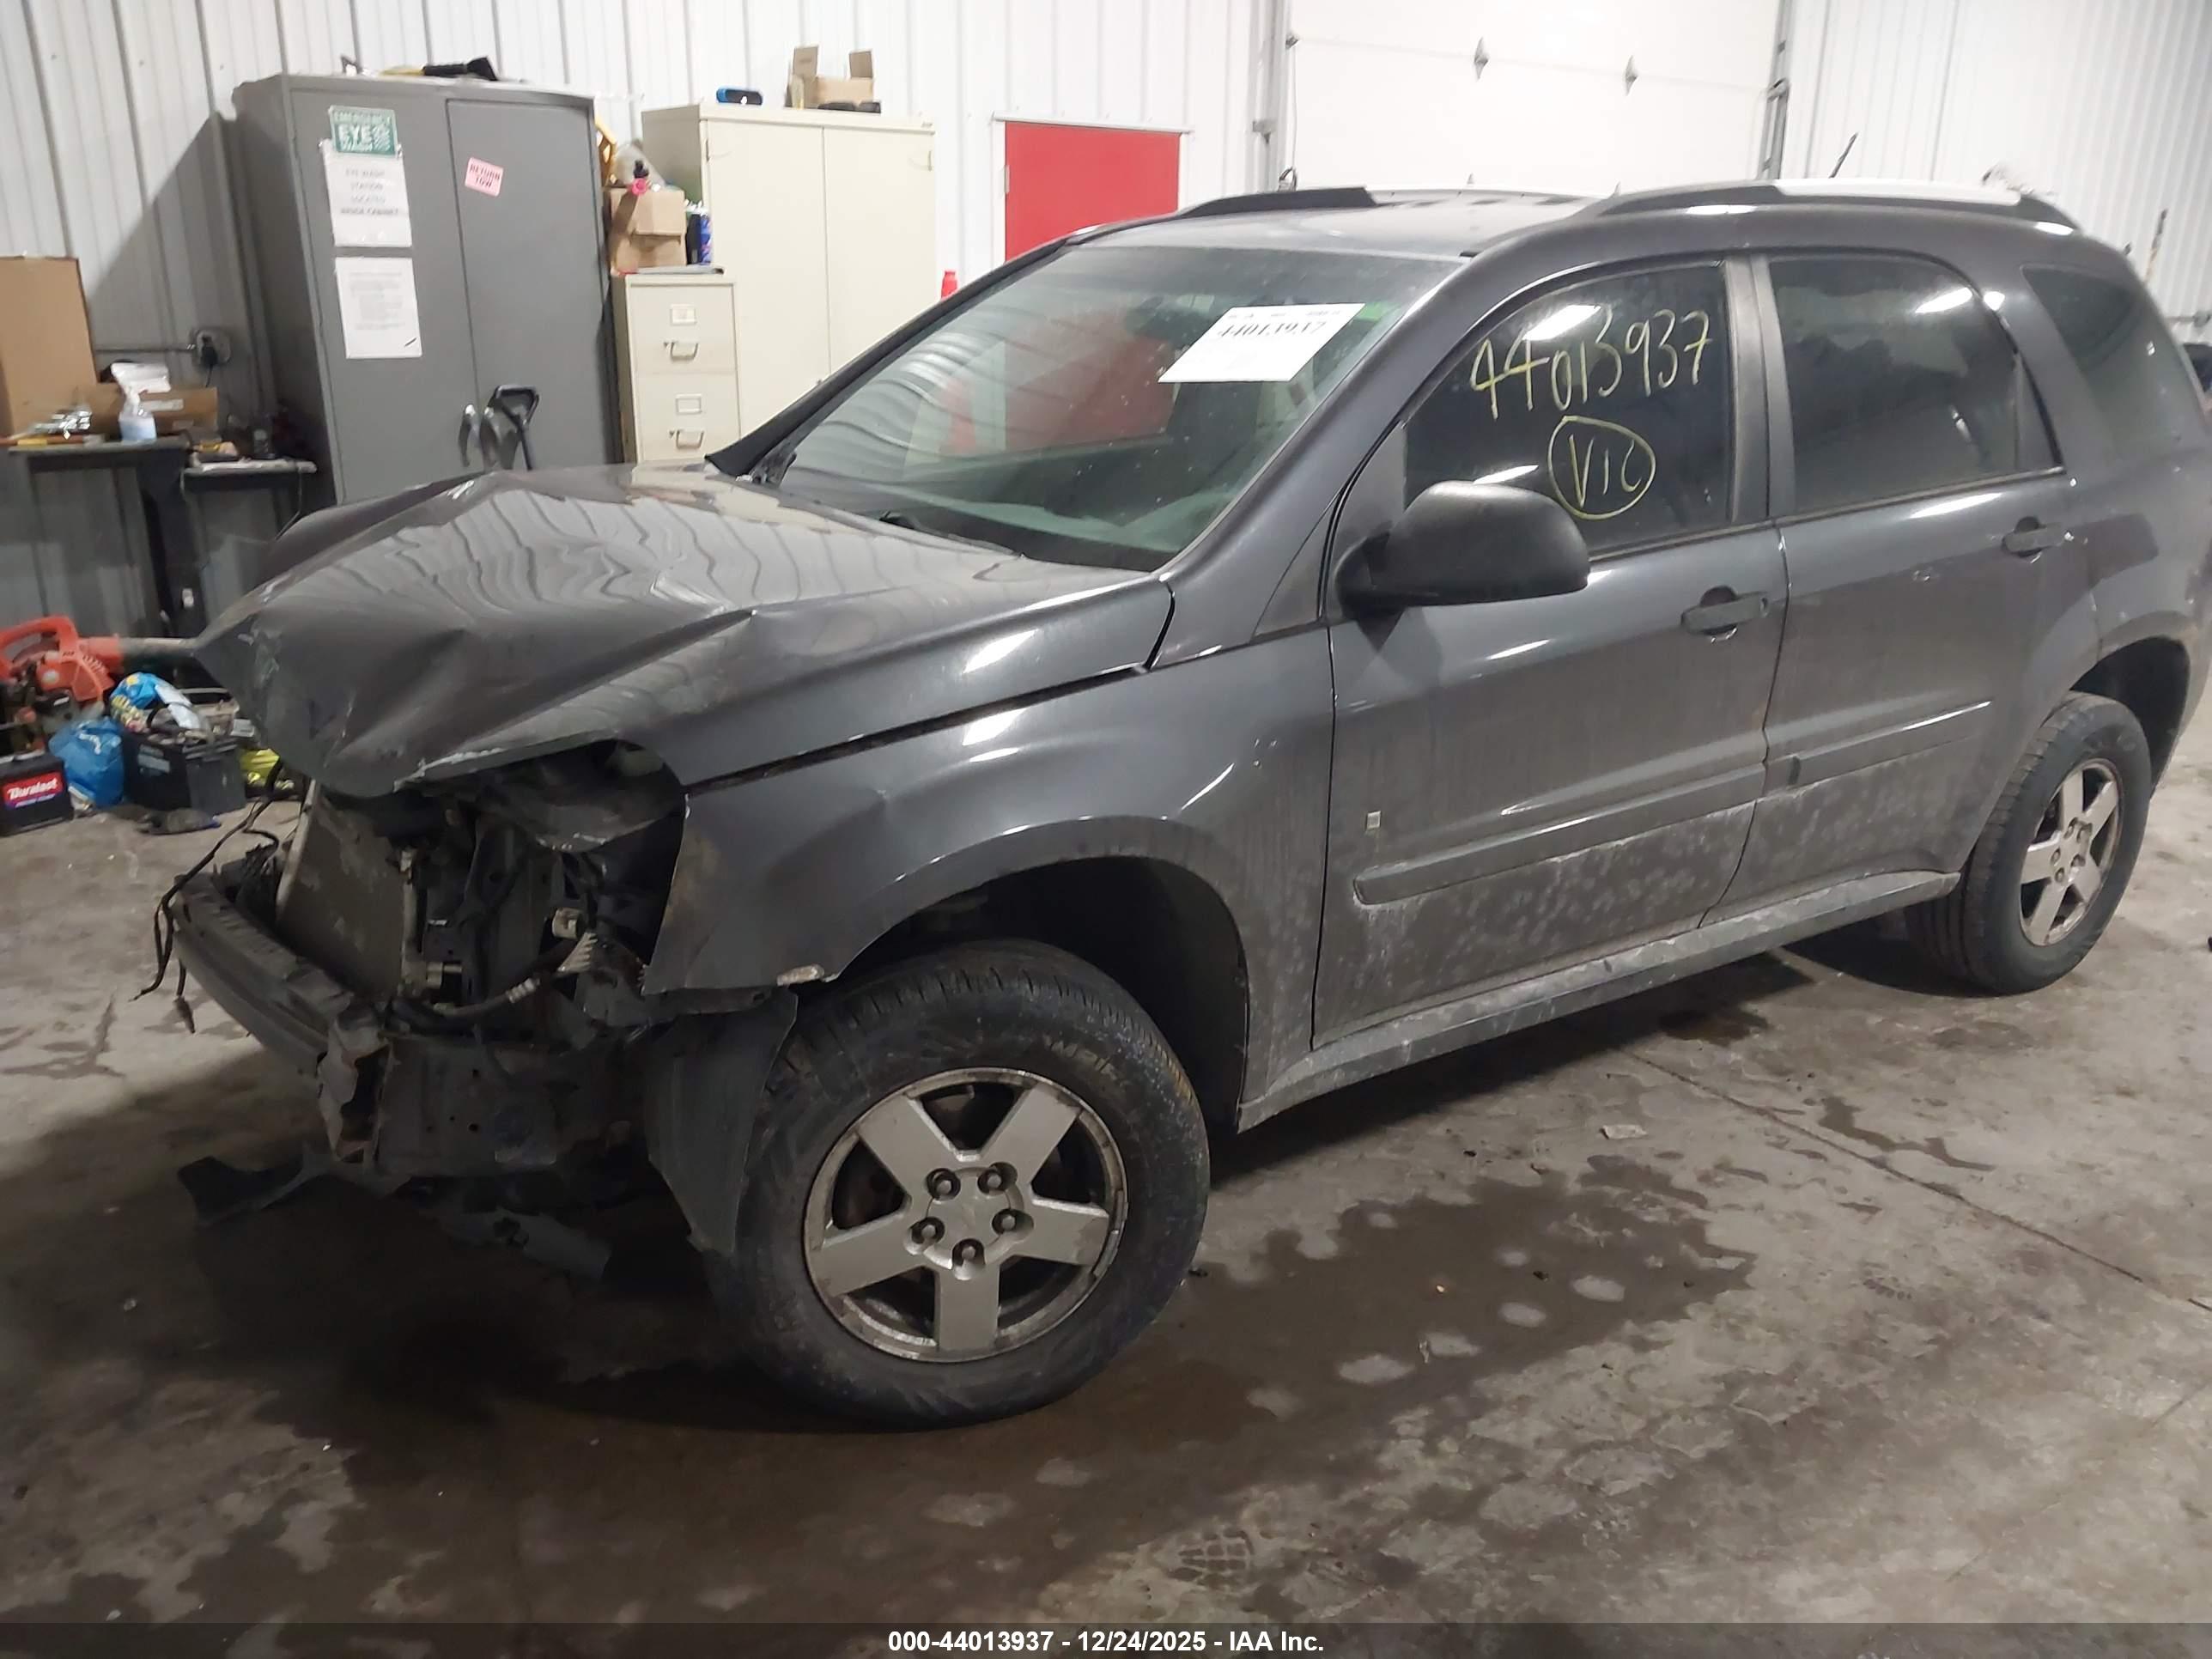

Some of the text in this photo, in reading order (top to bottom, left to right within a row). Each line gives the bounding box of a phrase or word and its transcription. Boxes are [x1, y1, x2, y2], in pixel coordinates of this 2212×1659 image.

[337, 123, 373, 144] EYE
[1469, 304, 1712, 421] 44013937
[1568, 434, 1643, 508] VIC
[7, 778, 58, 800] Duralast
